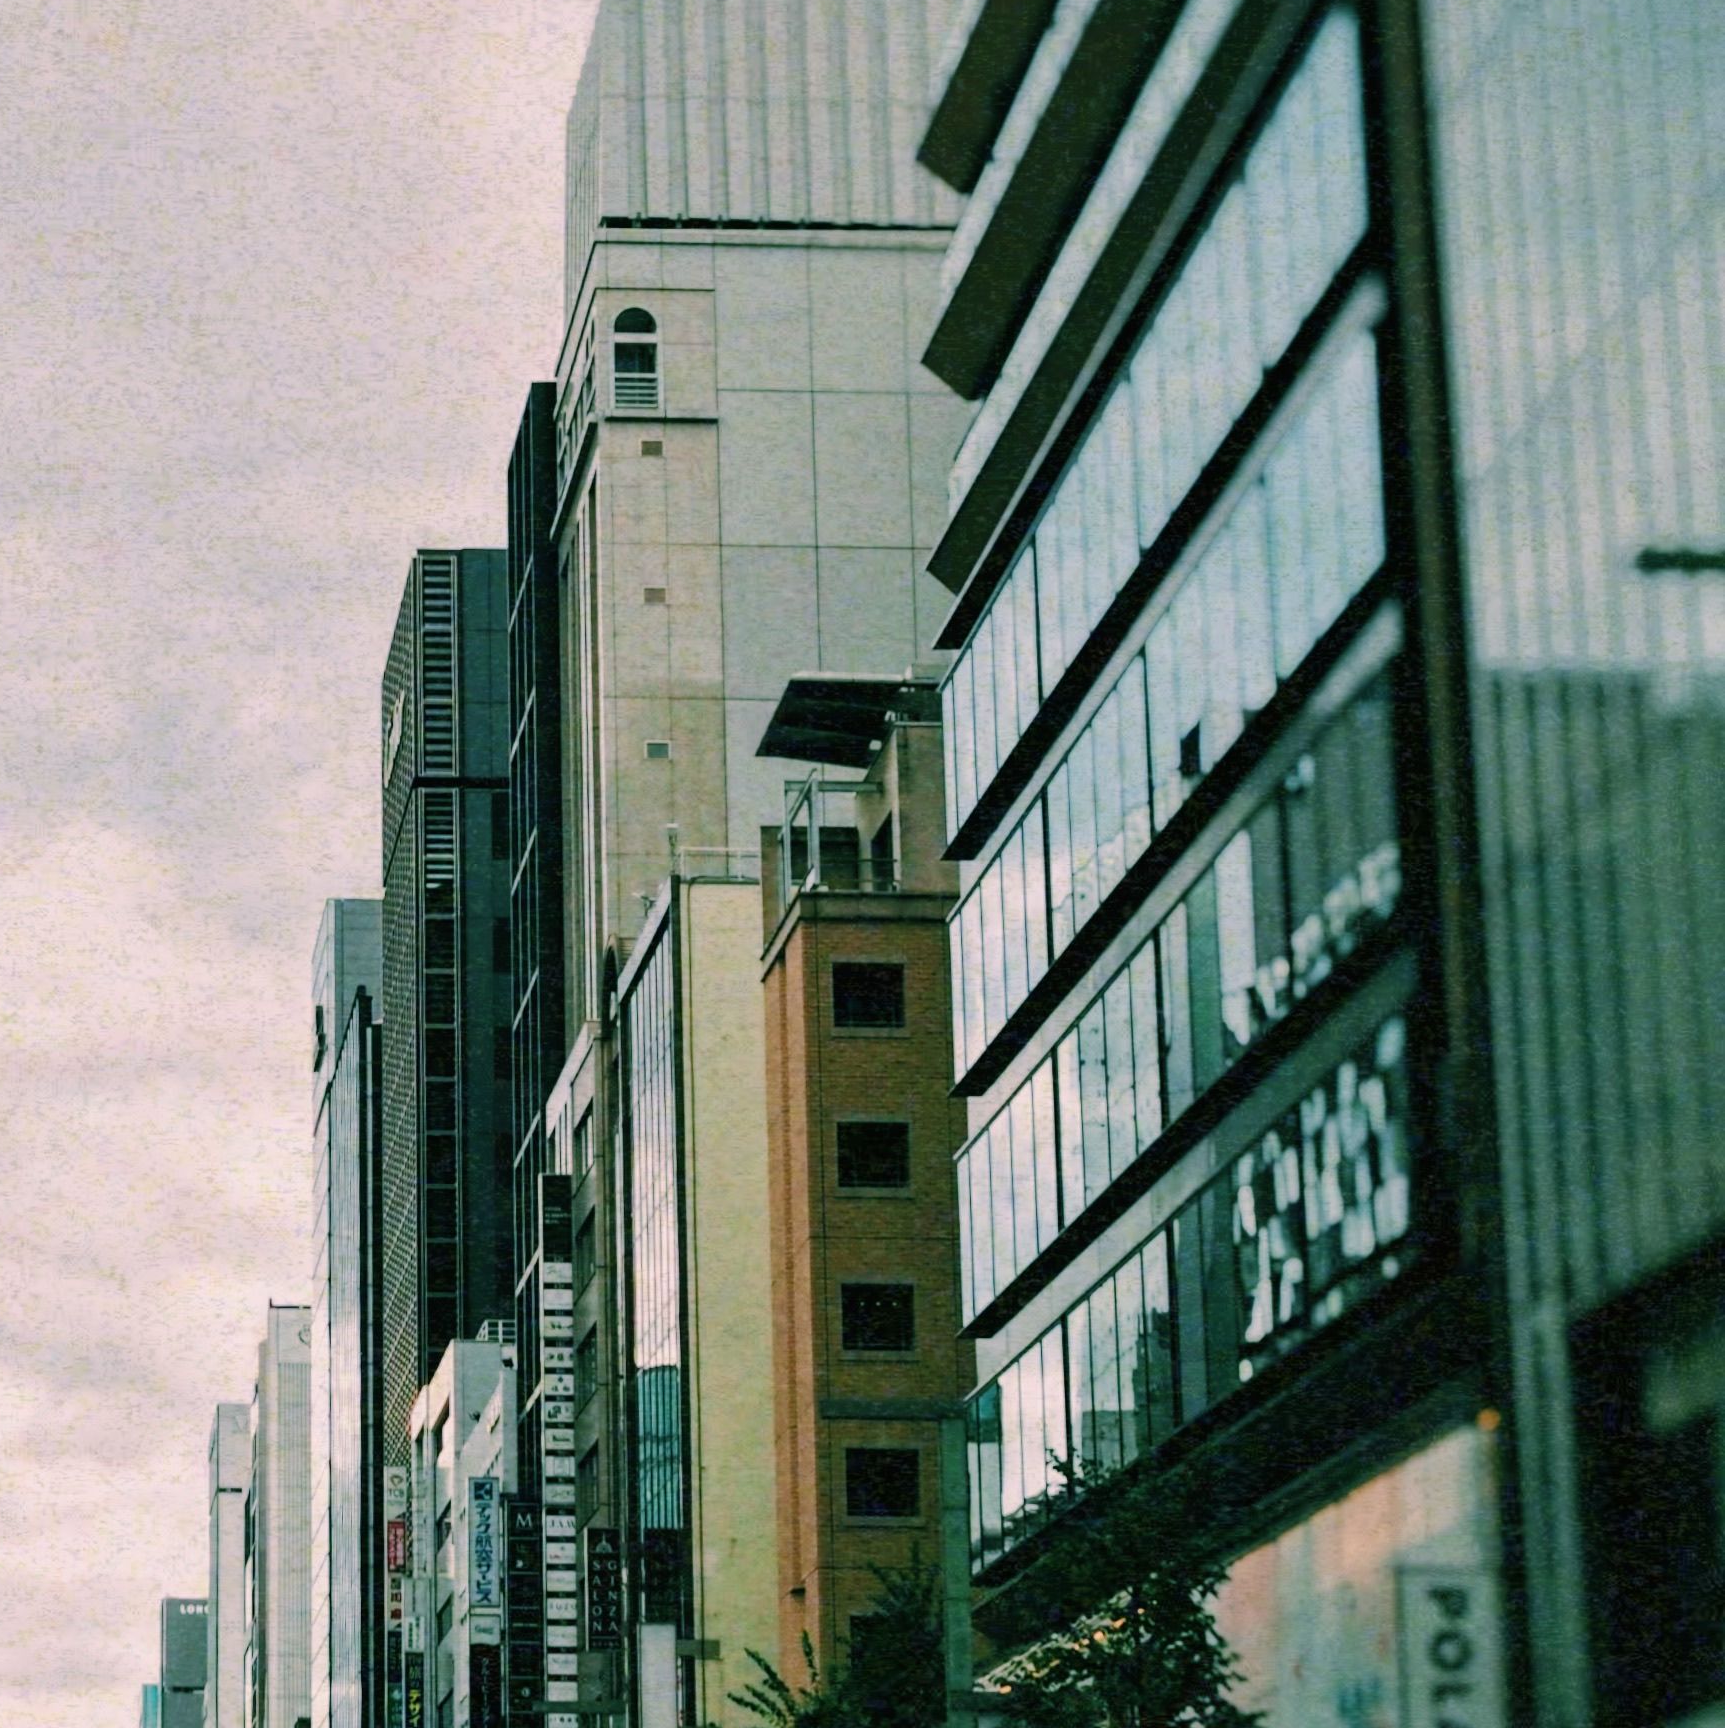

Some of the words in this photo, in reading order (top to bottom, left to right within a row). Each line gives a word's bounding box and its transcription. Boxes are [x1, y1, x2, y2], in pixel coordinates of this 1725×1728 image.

[475, 1503, 493, 1603] テック航空サービス
[591, 1560, 603, 1632] SALON
[607, 1560, 619, 1632] GINZA
